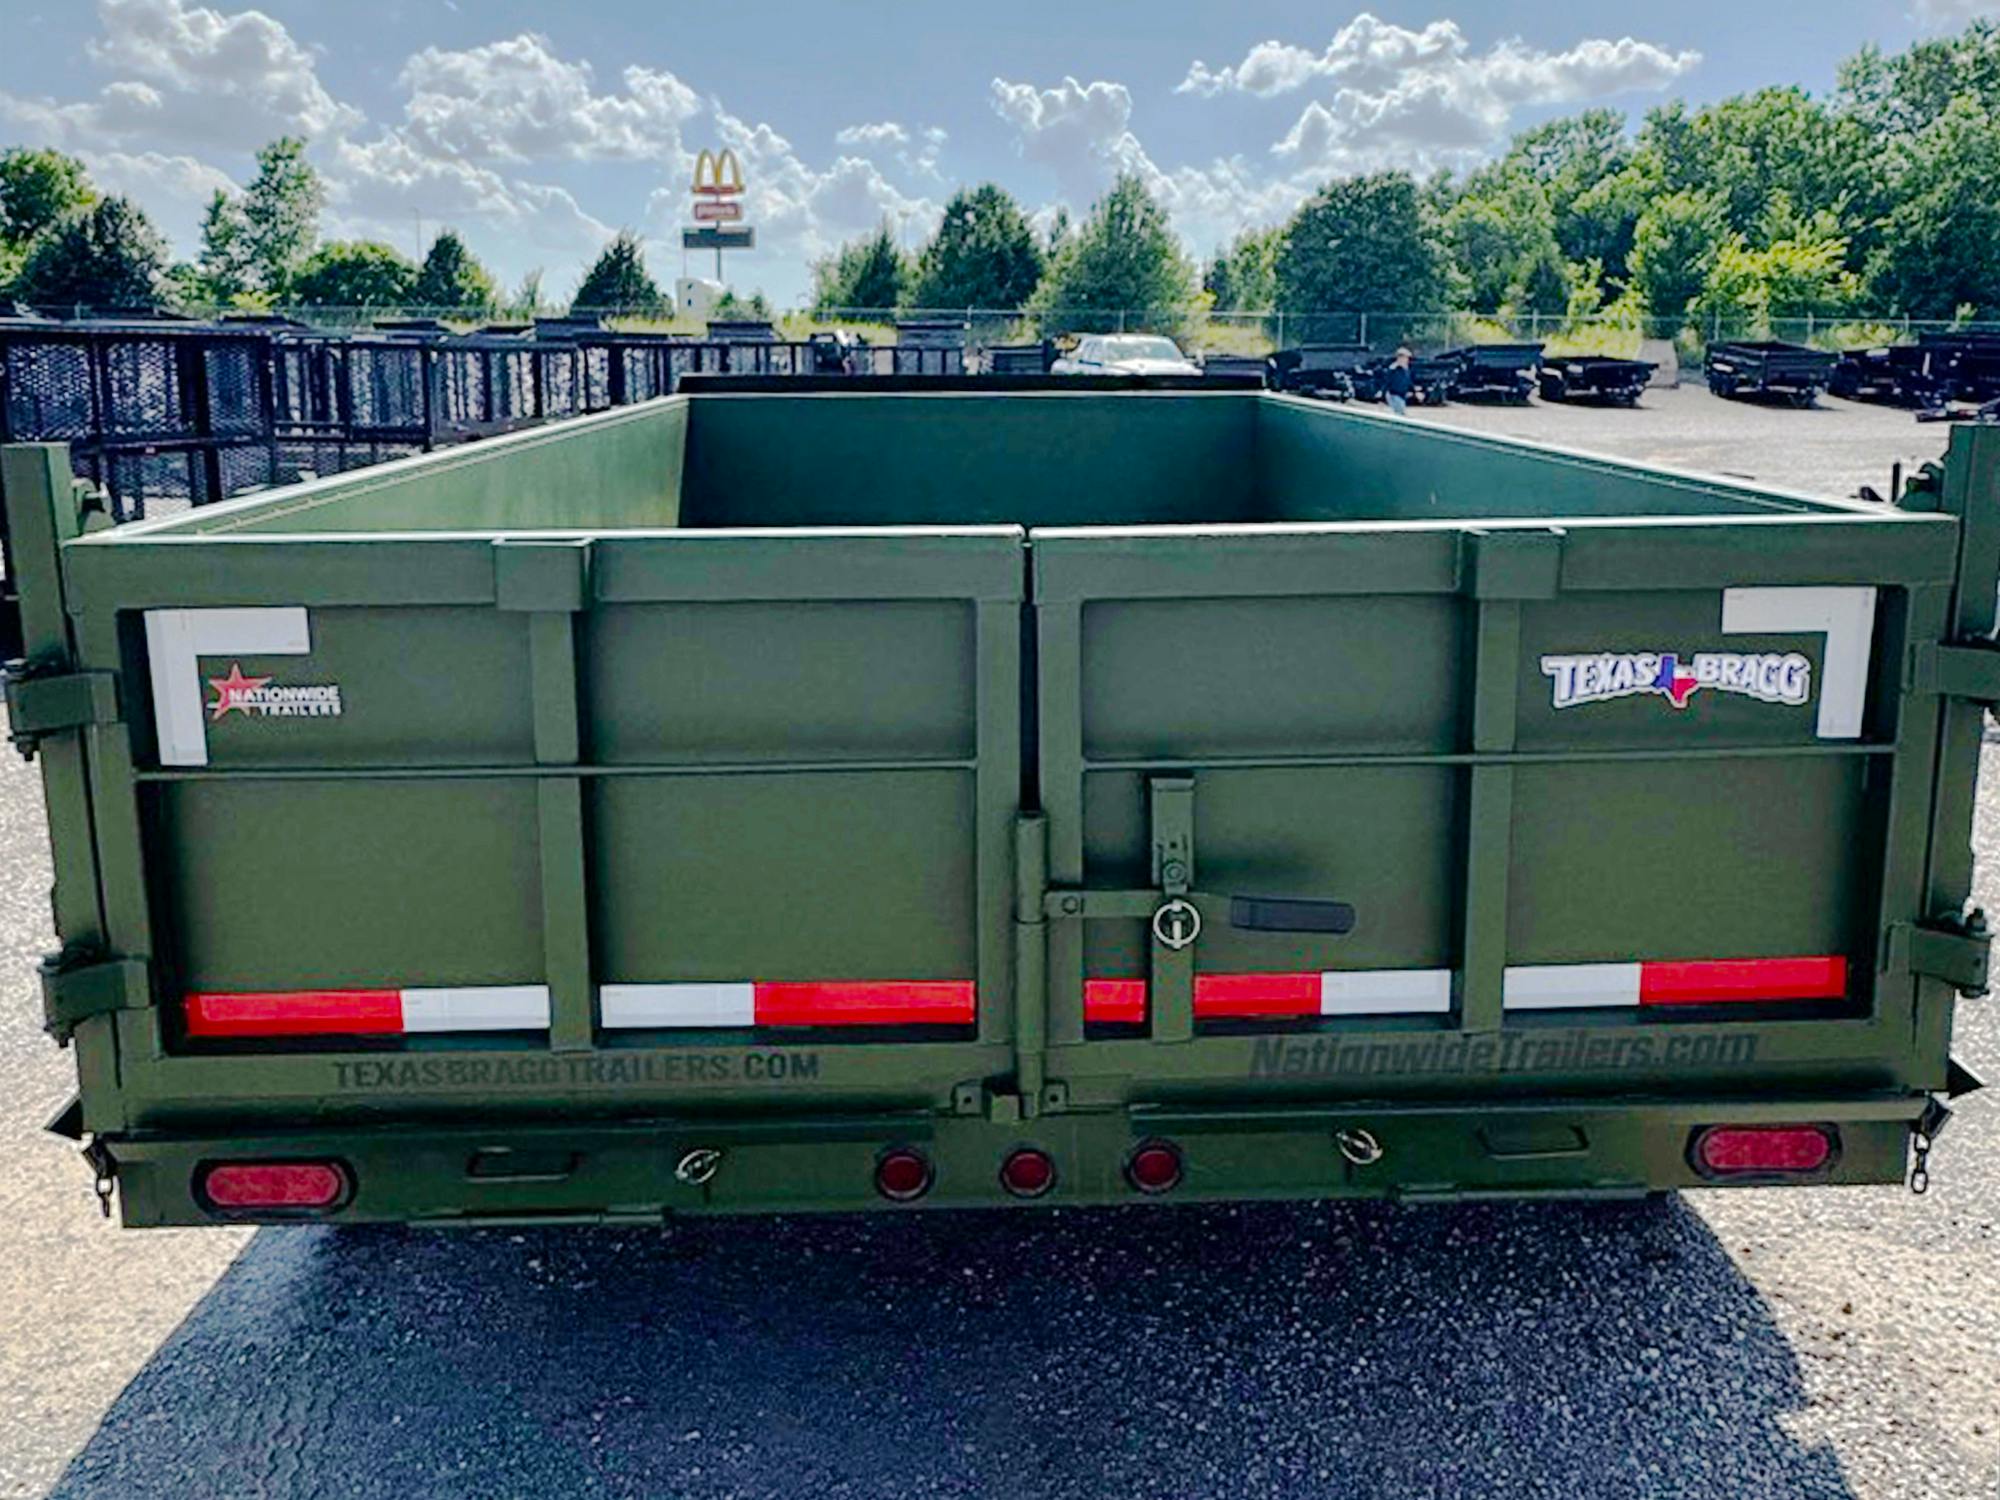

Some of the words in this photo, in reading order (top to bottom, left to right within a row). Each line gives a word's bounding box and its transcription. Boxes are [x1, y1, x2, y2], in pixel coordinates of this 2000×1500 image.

[1541, 653, 1660, 707] TEXAS
[1694, 653, 1810, 705] BRAGG
[333, 1052, 819, 1088] TEXASBRAGGTRAILERS.COM
[1250, 1033, 1758, 1076] NationwideTrailers.com
